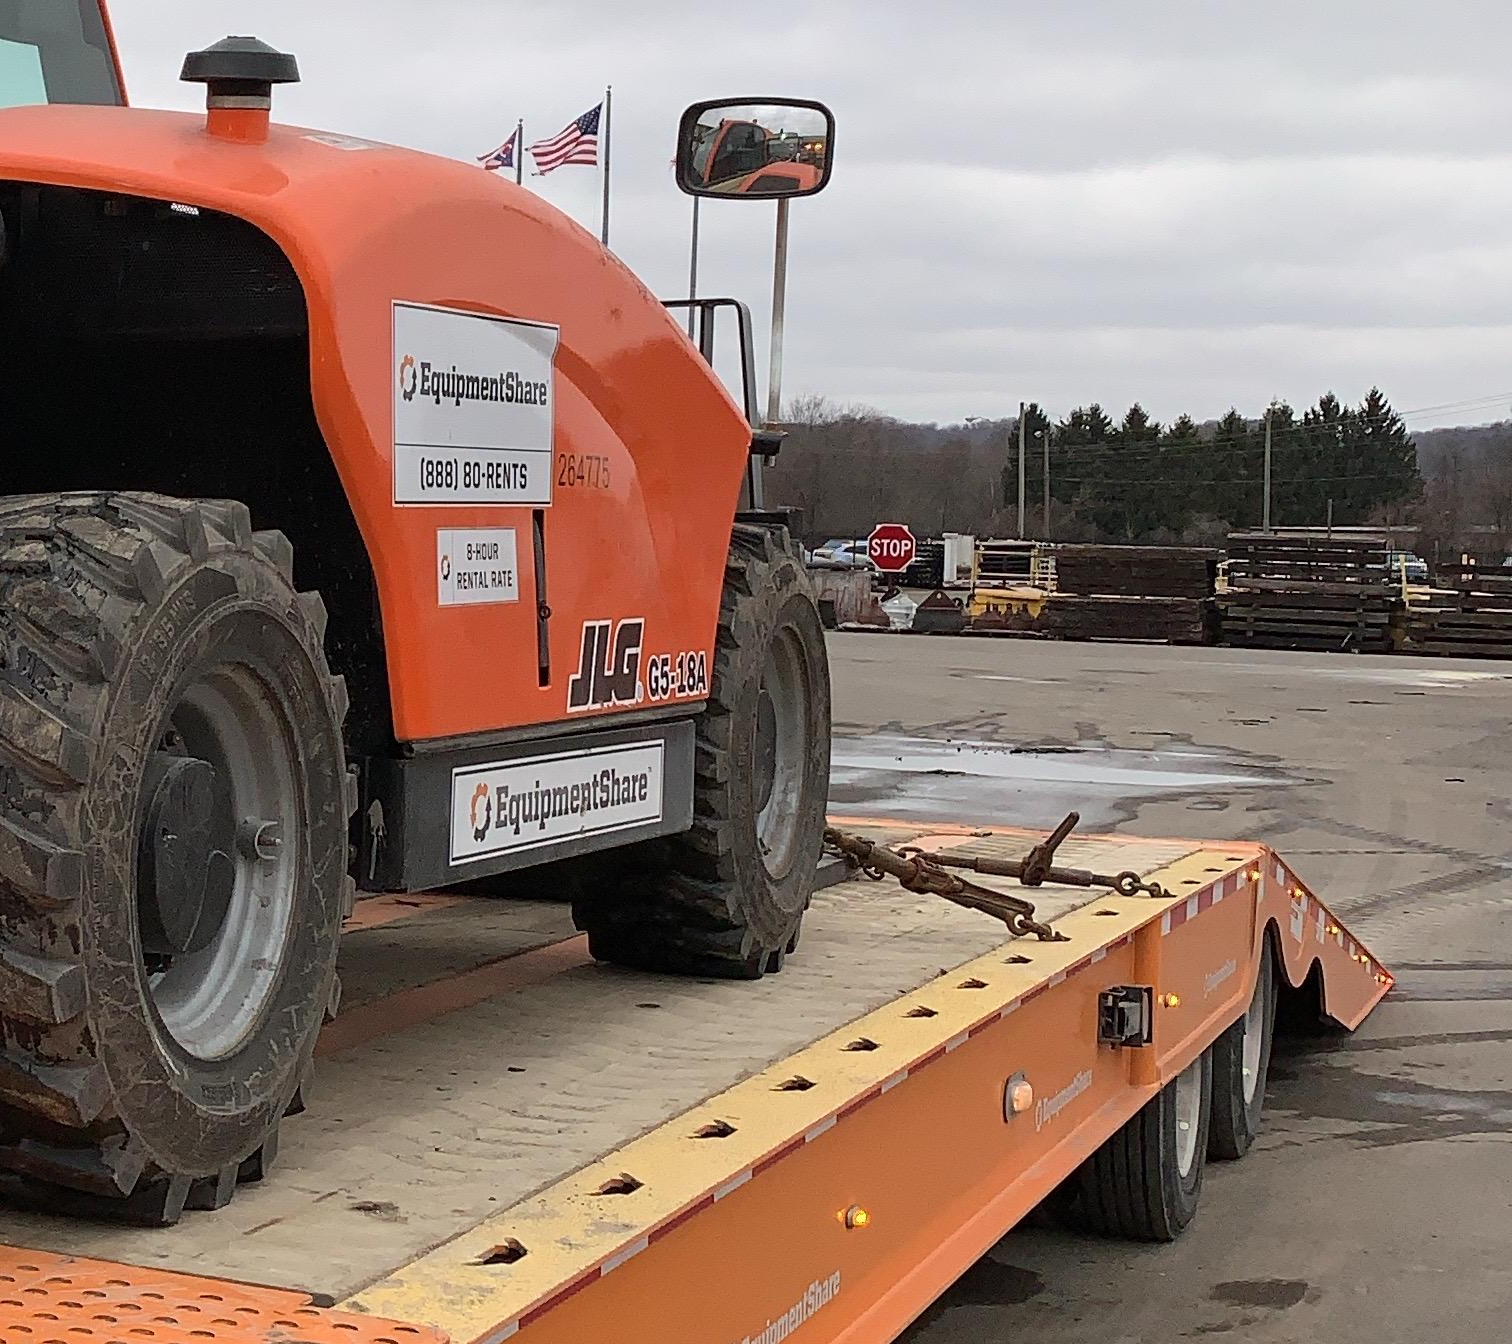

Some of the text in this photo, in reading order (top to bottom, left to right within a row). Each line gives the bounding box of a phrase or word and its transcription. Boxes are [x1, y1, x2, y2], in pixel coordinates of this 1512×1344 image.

[420, 362, 548, 407] EquipmentShare
[420, 457, 459, 491] (888)
[557, 453, 610, 490] 264775
[466, 542, 500, 561] 8-HOUR
[871, 538, 912, 558] STOP
[456, 570, 513, 590] RENTAL RATE
[566, 617, 645, 714] JLG
[646, 650, 710, 702] G5-18A
[494, 767, 648, 836] EquipmentShare
